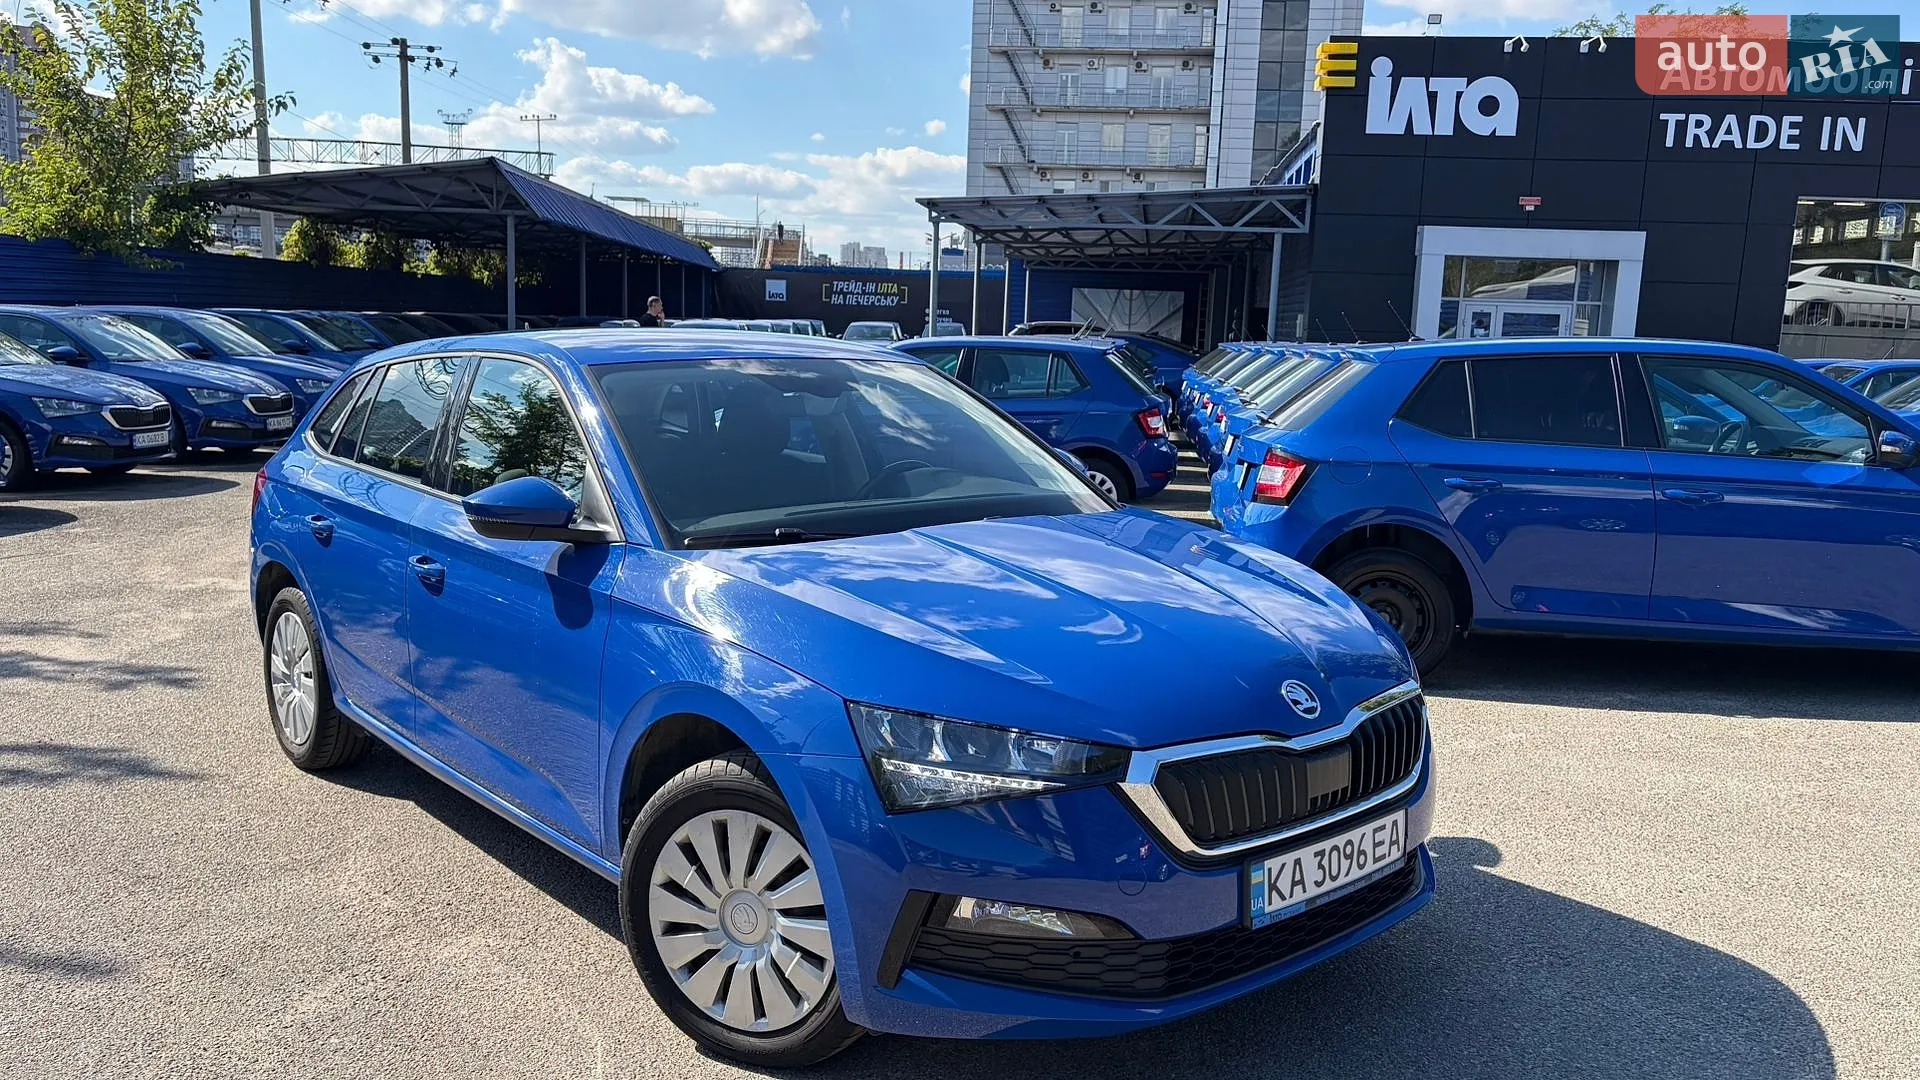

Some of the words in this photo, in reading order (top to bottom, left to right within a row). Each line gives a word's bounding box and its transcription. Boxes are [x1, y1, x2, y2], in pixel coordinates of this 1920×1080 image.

[1659, 113, 1803, 151] TRADE
[1819, 116, 1866, 152] IN
[832, 280, 876, 294] ТРЕЙД-ІН
[877, 282, 898, 294] ІЛТА
[831, 294, 844, 304] НА
[845, 294, 899, 306] ПЕЧЕРСЬКУ
[1267, 857, 1307, 906] KA
[1314, 832, 1368, 888] 3096
[1372, 818, 1401, 865] EA
[1251, 897, 1264, 911] UA
